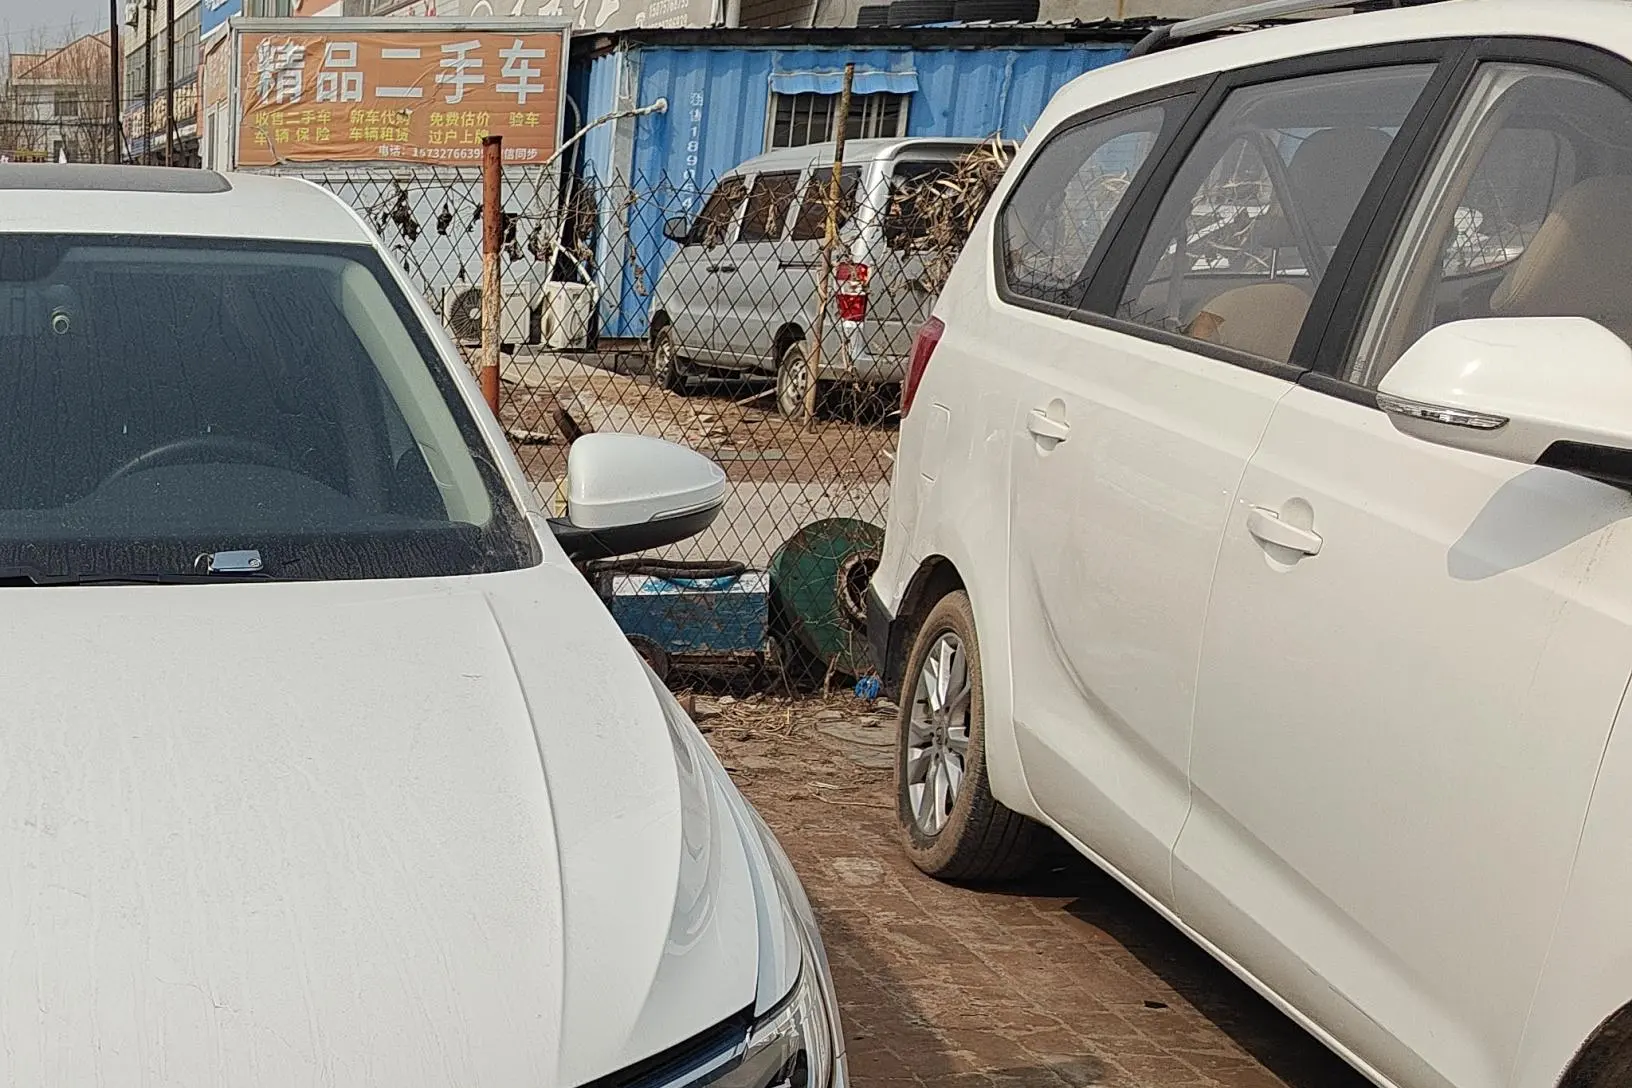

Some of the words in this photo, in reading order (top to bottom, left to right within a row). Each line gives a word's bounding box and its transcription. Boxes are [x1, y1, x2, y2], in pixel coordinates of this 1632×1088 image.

[256, 37, 546, 105] 精品二手车
[254, 110, 332, 127] 收售二手车
[430, 111, 490, 127] 免费估价
[508, 111, 540, 128] 验车
[254, 127, 331, 145] 车辆保险
[349, 127, 410, 143] 车辆租赁
